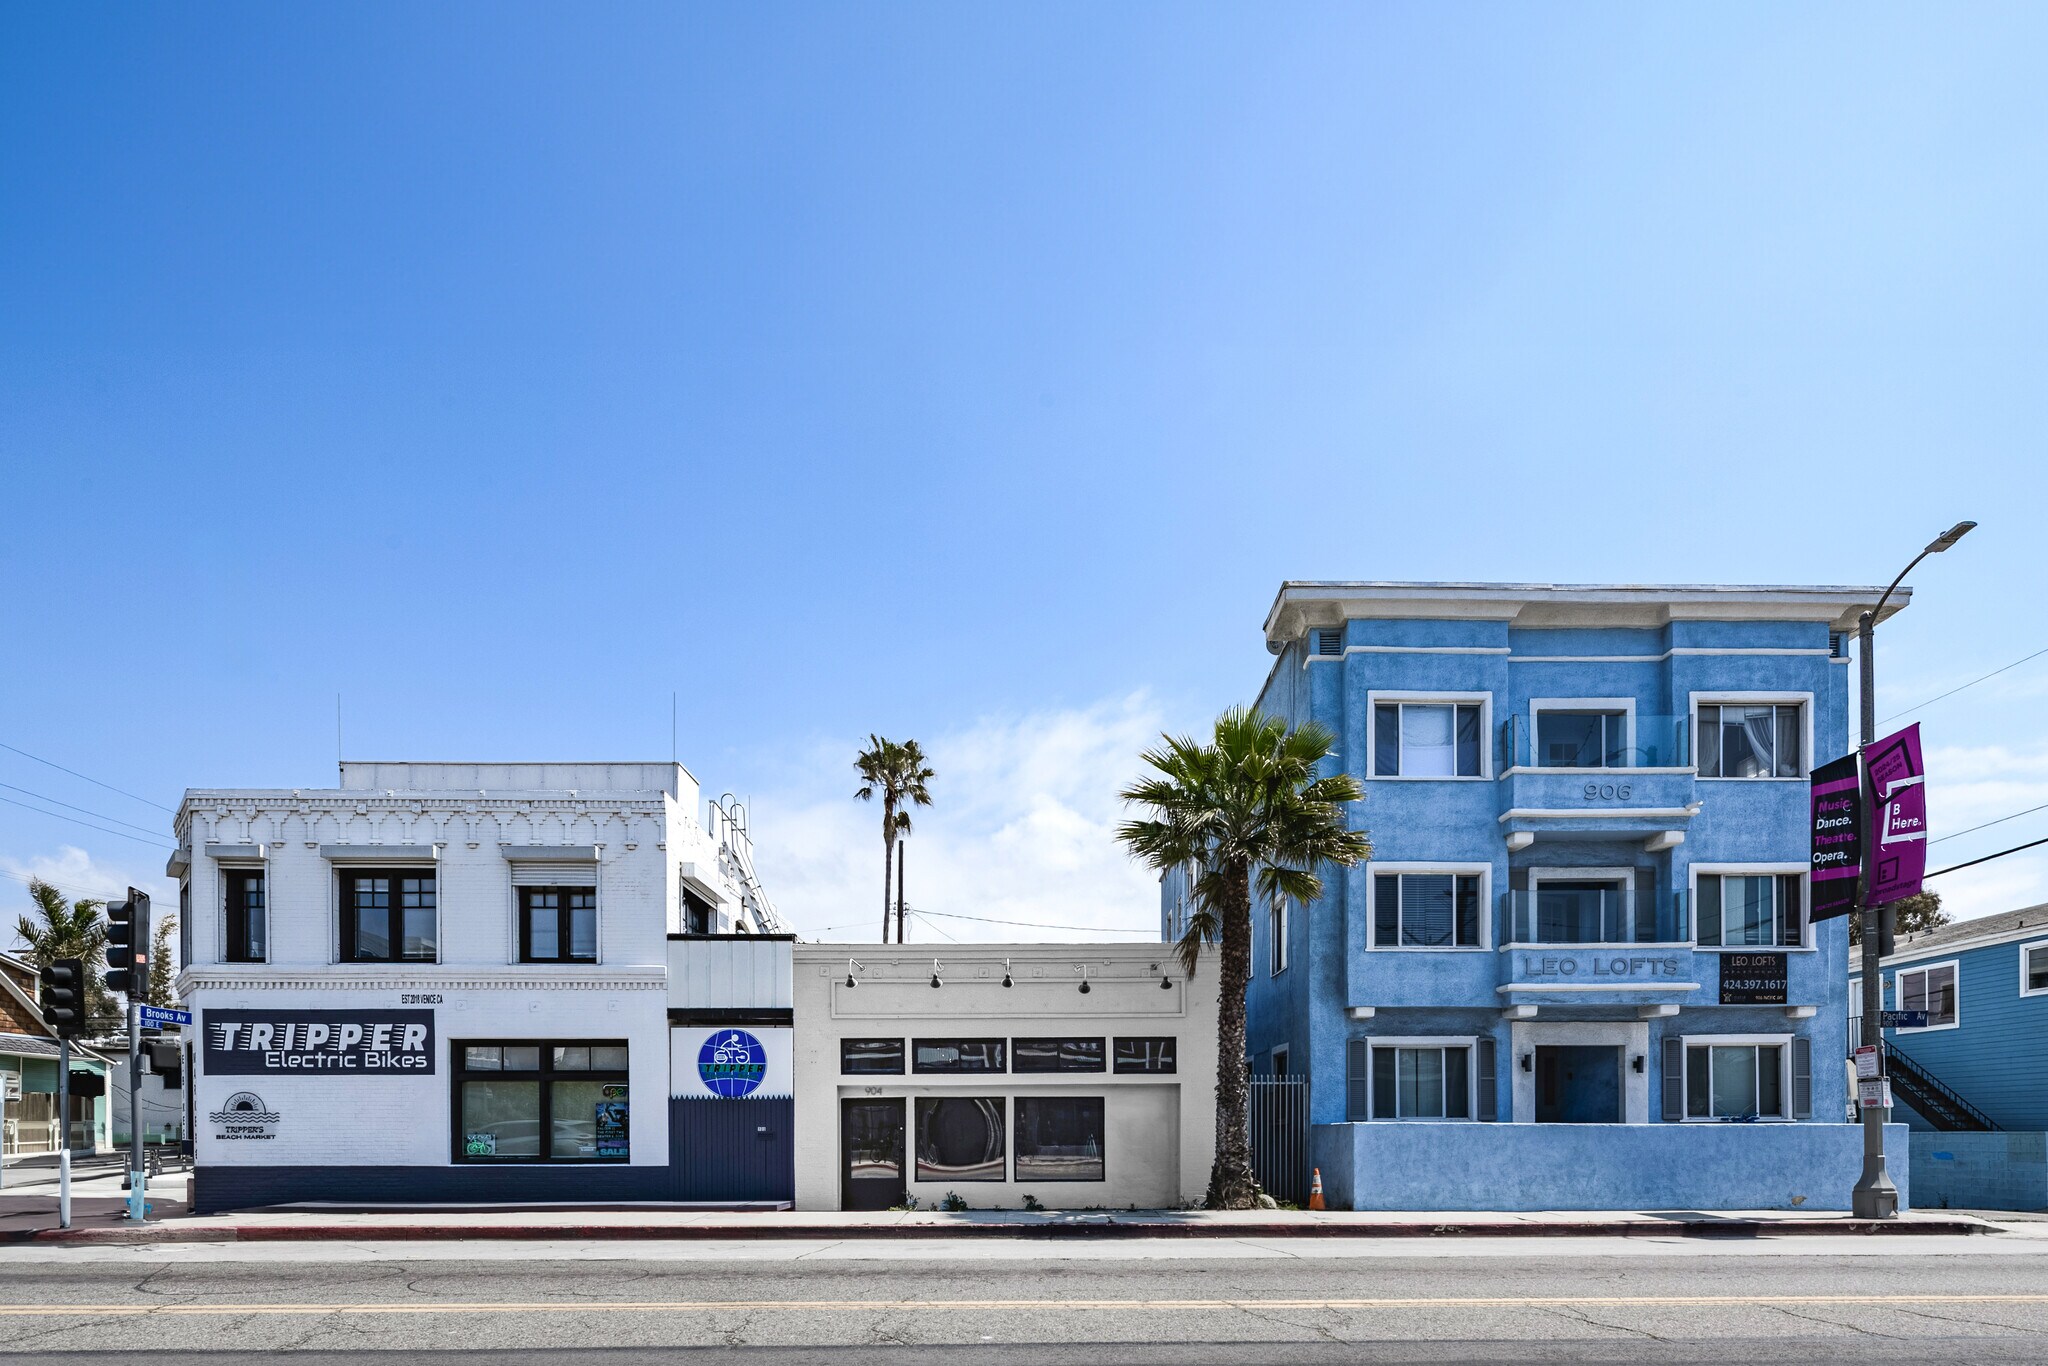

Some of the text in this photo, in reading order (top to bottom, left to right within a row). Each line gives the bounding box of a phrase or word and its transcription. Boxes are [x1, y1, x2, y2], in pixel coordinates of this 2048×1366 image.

[1877, 761, 1902, 783] SEASON
[1583, 784, 1632, 800] 906
[1818, 798, 1853, 813] Music.
[1893, 803, 1901, 815] B
[1816, 817, 1852, 830] Dance.
[1891, 817, 1922, 830] Here.
[1815, 832, 1857, 847] Theatre.
[1812, 851, 1848, 865] Opera.
[1525, 957, 1679, 976] LEO LOFTS
[1731, 956, 1776, 966] LEO LOFTS
[1723, 980, 1787, 990] 424.397.1617
[420, 994, 436, 1004] VENICE
[436, 994, 443, 1004] CA
[146, 1008, 186, 1022] Brooks Av
[1882, 1012, 1926, 1020] Pacific Av
[208, 1022, 428, 1051] TRIPPER
[265, 1051, 428, 1068] Electric Bikes
[706, 1064, 764, 1072] TRIPPER
[865, 1086, 882, 1096] 904
